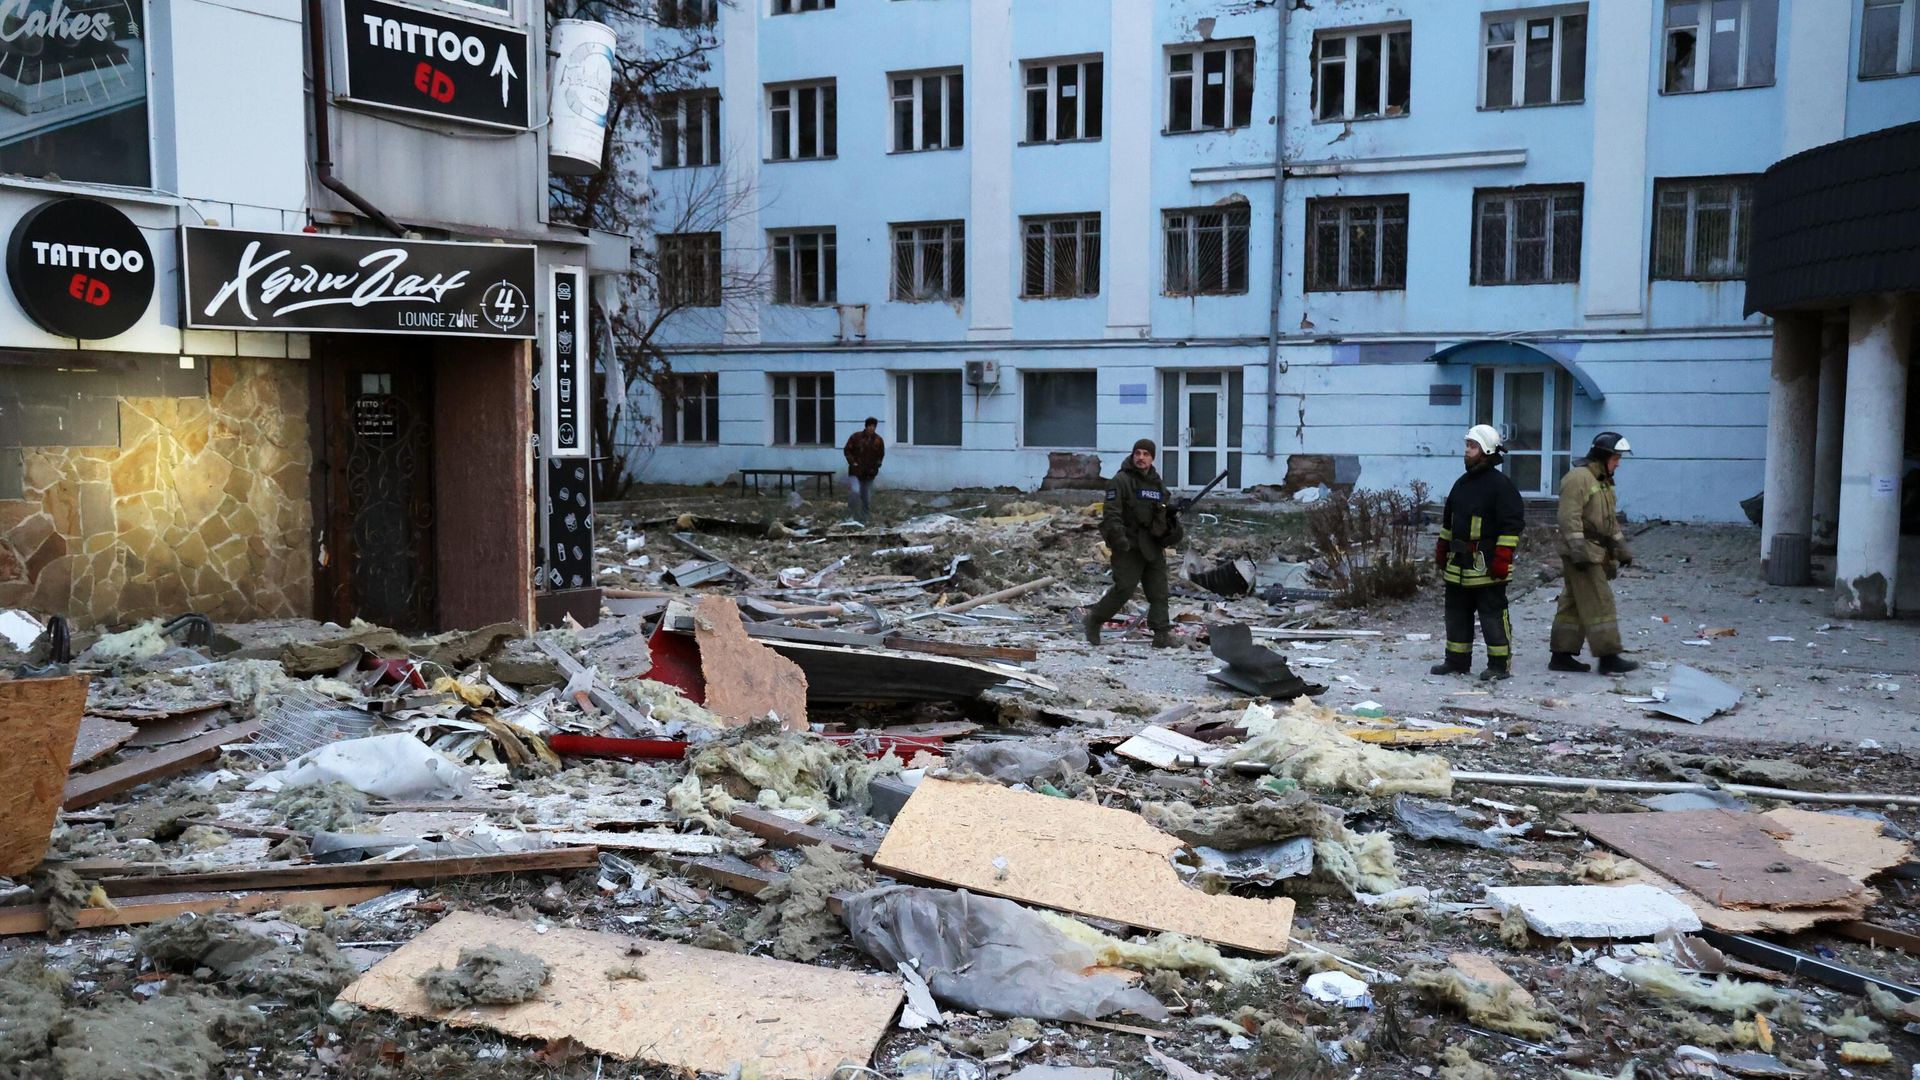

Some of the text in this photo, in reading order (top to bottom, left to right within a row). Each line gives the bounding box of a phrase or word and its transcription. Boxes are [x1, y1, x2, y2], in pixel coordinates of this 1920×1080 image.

[0, 0, 115, 42] Cakes
[363, 14, 486, 66] TATTOO
[414, 61, 456, 104] ED
[32, 241, 144, 273] TATTOO
[69, 273, 111, 307] ED
[494, 288, 516, 315] 4
[398, 311, 446, 328] LOUNGE
[494, 314, 516, 323] ЭТАЖ
[1141, 490, 1160, 500] PRESS
